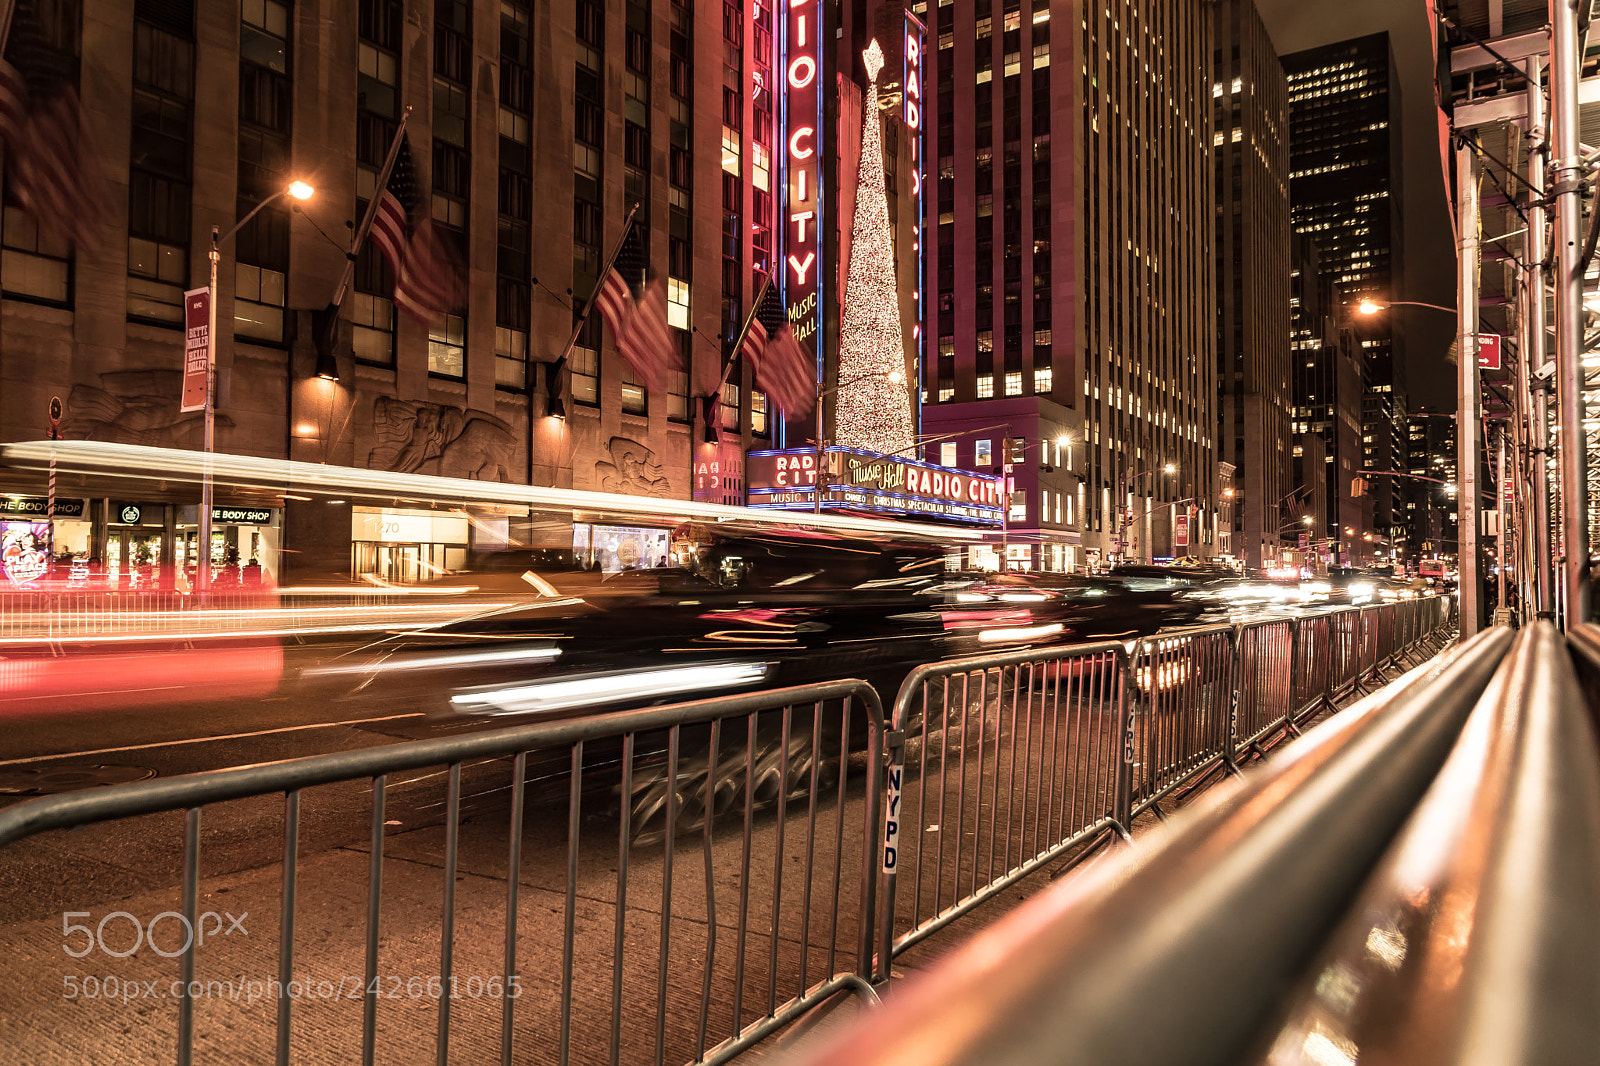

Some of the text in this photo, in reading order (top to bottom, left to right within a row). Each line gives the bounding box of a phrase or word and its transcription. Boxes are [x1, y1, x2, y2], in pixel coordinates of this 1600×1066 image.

[788, 0, 816, 89] IO
[788, 126, 815, 285] CITY
[788, 292, 816, 327] MUSIC
[792, 317, 816, 343] HALL
[776, 455, 814, 470] RAD
[849, 458, 905, 490] Music Hall
[776, 470, 817, 485] CIT
[907, 467, 962, 499] RADIO
[18, 502, 49, 511] BODY
[53, 504, 80, 513] SHOP
[770, 491, 835, 503] MUSIC HLL
[873, 496, 906, 509] CHRISTMAS
[907, 500, 944, 514] SPECTACULAR
[222, 510, 247, 519] BODY
[247, 511, 269, 520] SHOP
[1125, 706, 1135, 761] YPD
[884, 769, 901, 869] NYPD
